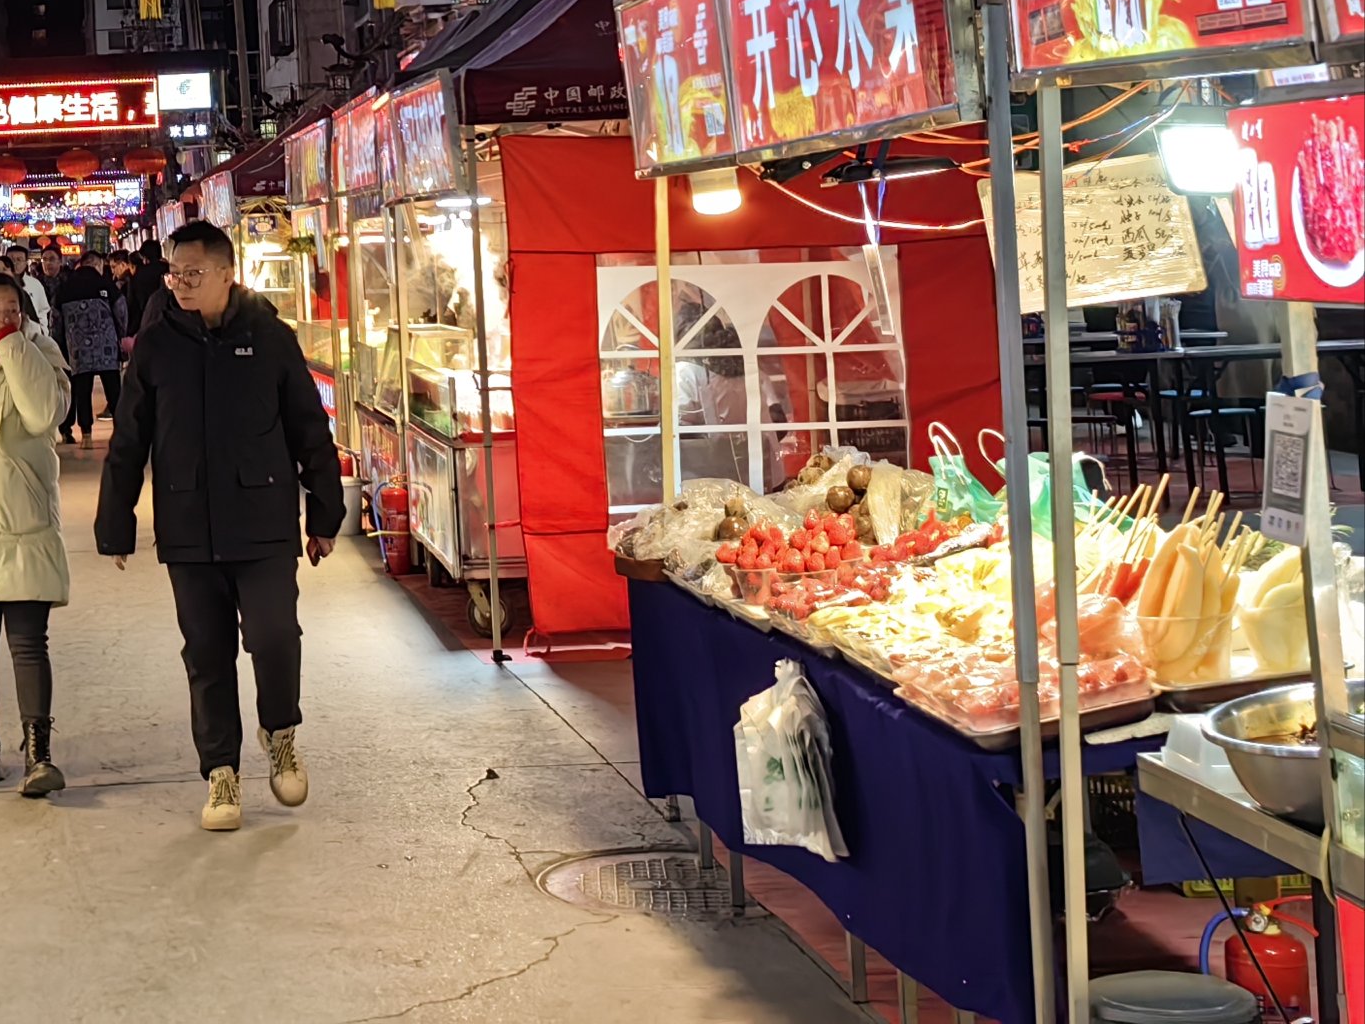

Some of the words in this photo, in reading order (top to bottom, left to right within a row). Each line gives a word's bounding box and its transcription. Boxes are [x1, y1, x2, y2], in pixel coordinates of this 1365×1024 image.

[543, 81, 627, 107] 中国邮政
[545, 106, 585, 115] POSTAL
